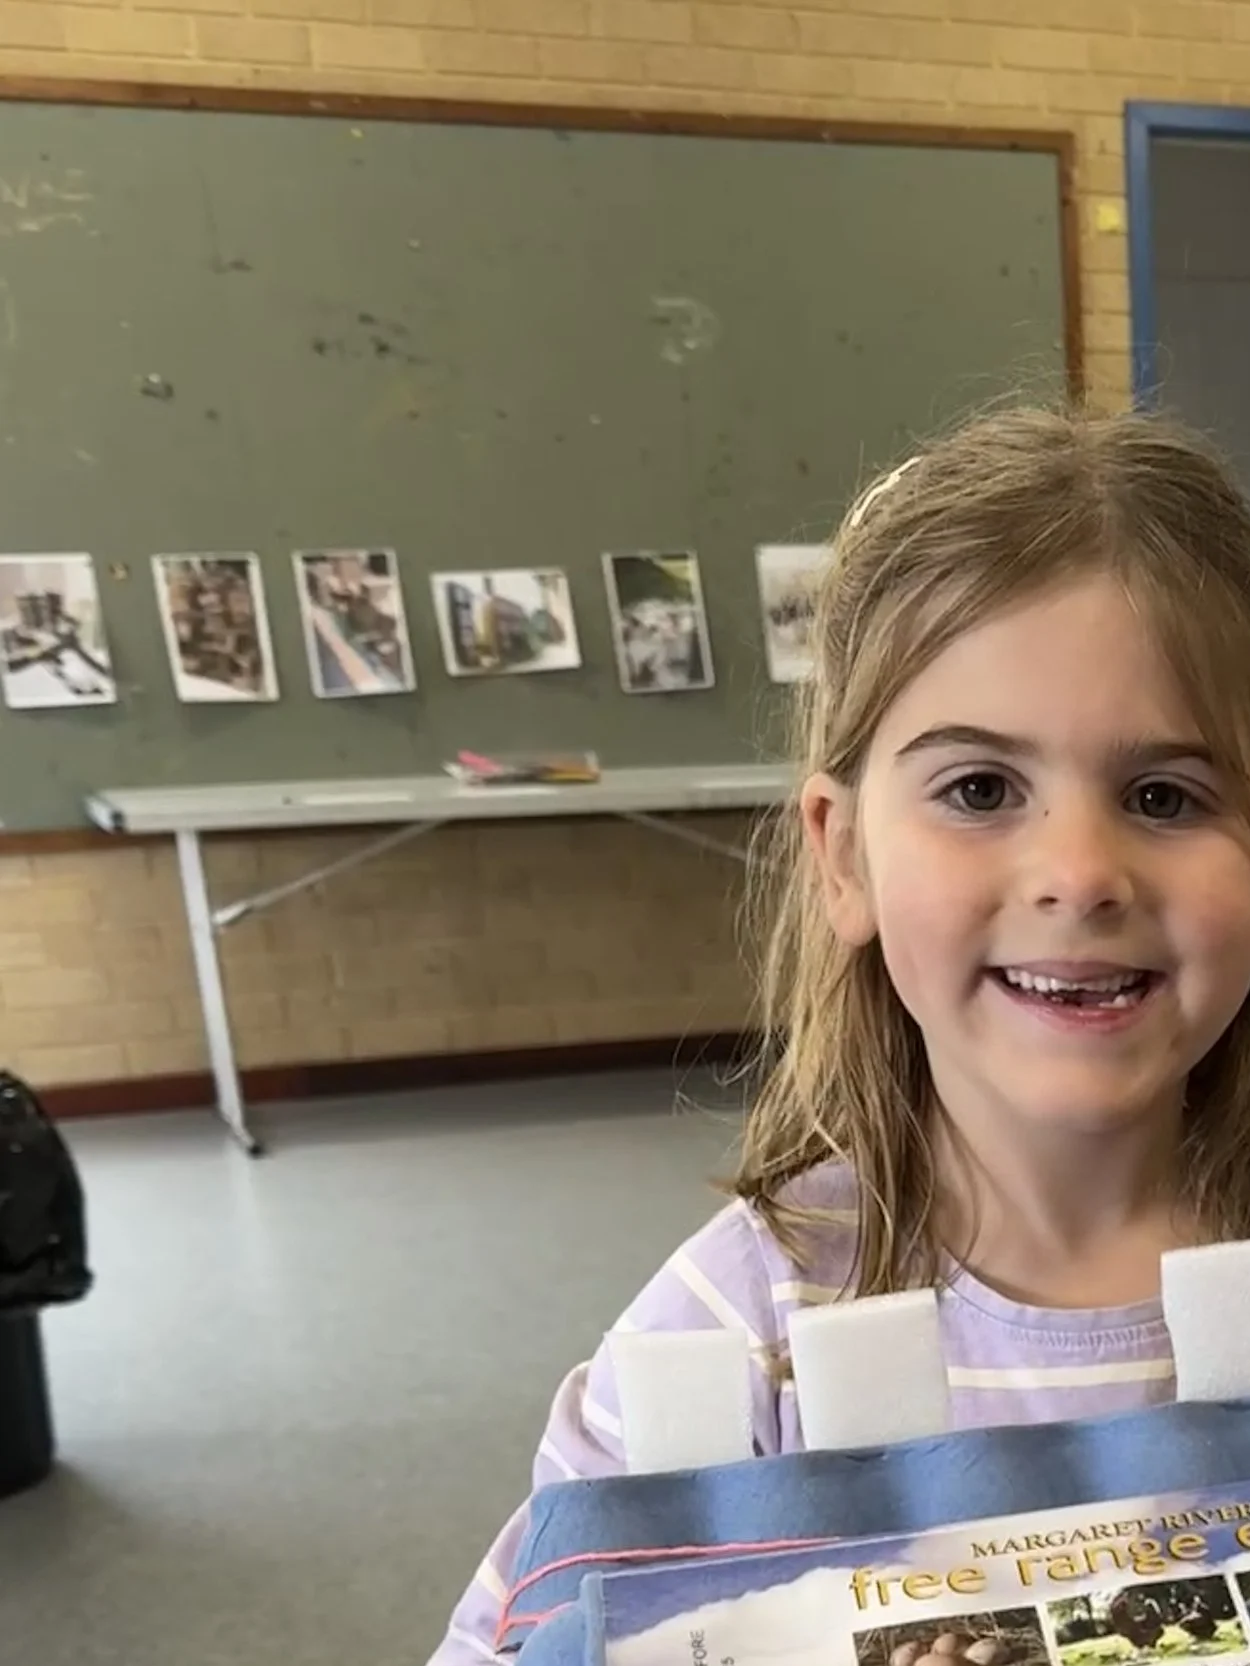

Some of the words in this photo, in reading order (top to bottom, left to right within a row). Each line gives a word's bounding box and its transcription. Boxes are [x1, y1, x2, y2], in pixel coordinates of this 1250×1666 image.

[971, 1517, 1152, 1559] MARGARET
[848, 1564, 987, 1611] free
[1016, 1531, 1211, 1588] range
